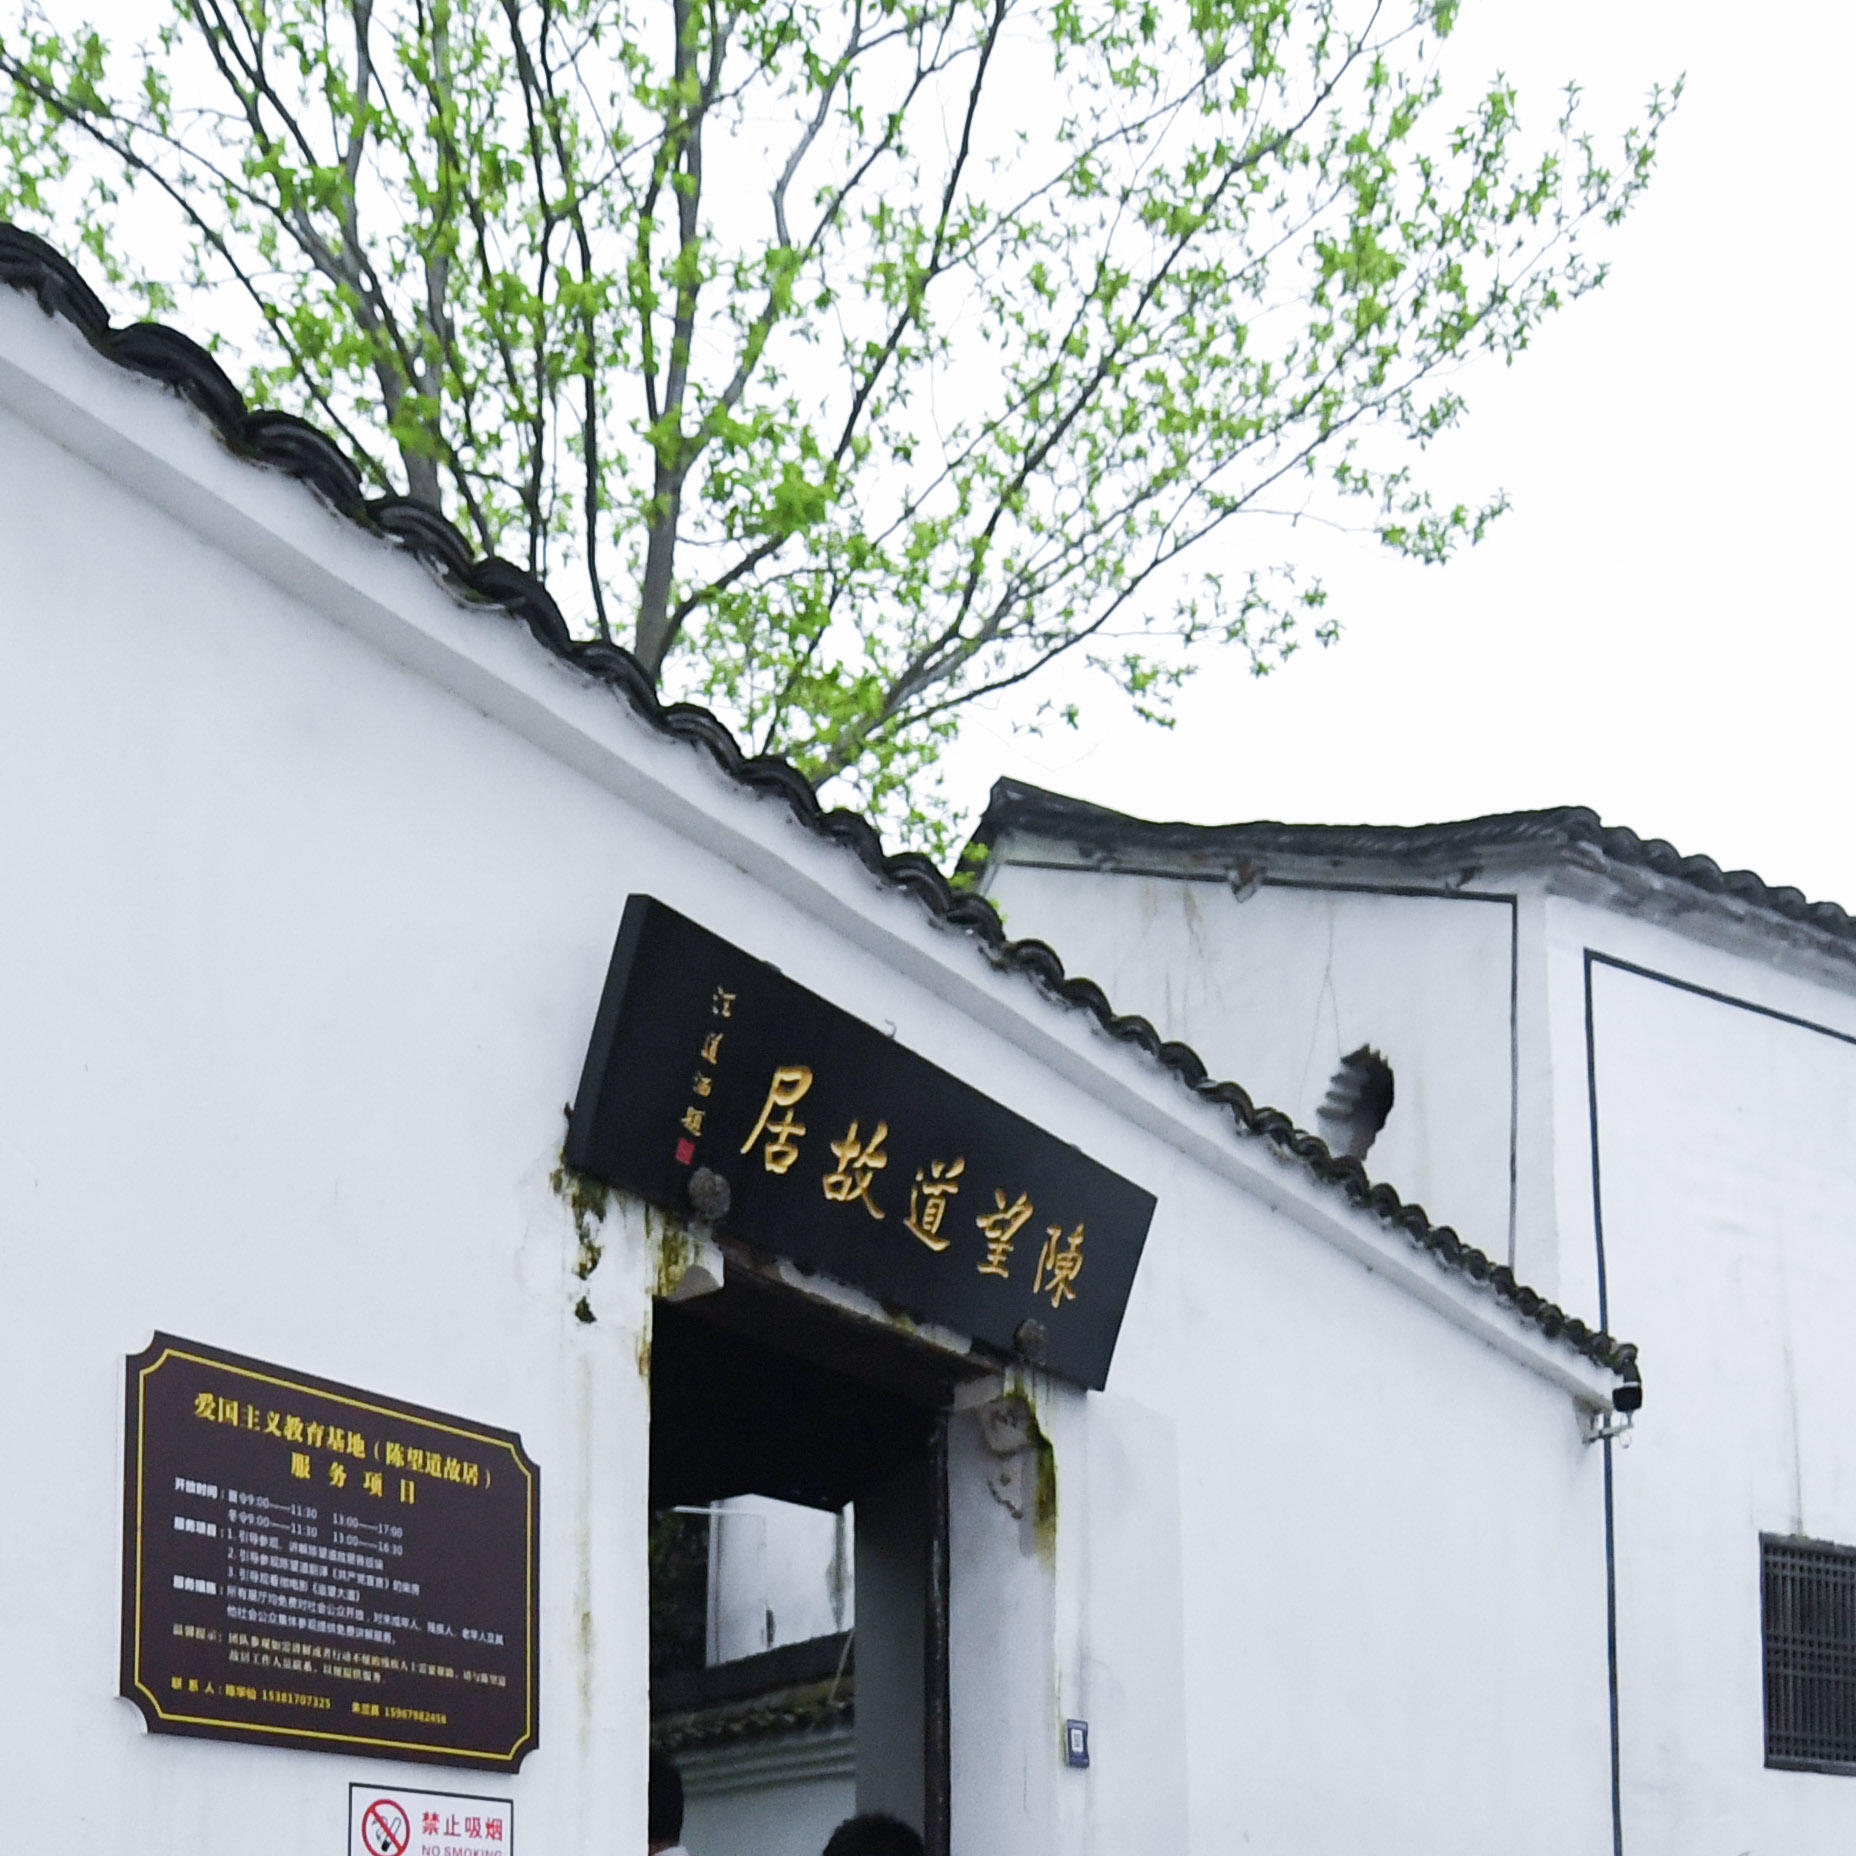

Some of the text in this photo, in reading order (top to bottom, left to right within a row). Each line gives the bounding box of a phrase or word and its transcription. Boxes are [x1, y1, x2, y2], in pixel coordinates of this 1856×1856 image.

[290, 1450, 416, 1506] 服务项目
[422, 1811, 503, 1841] 禁止吸烟
[422, 1844, 441, 1856] NO
